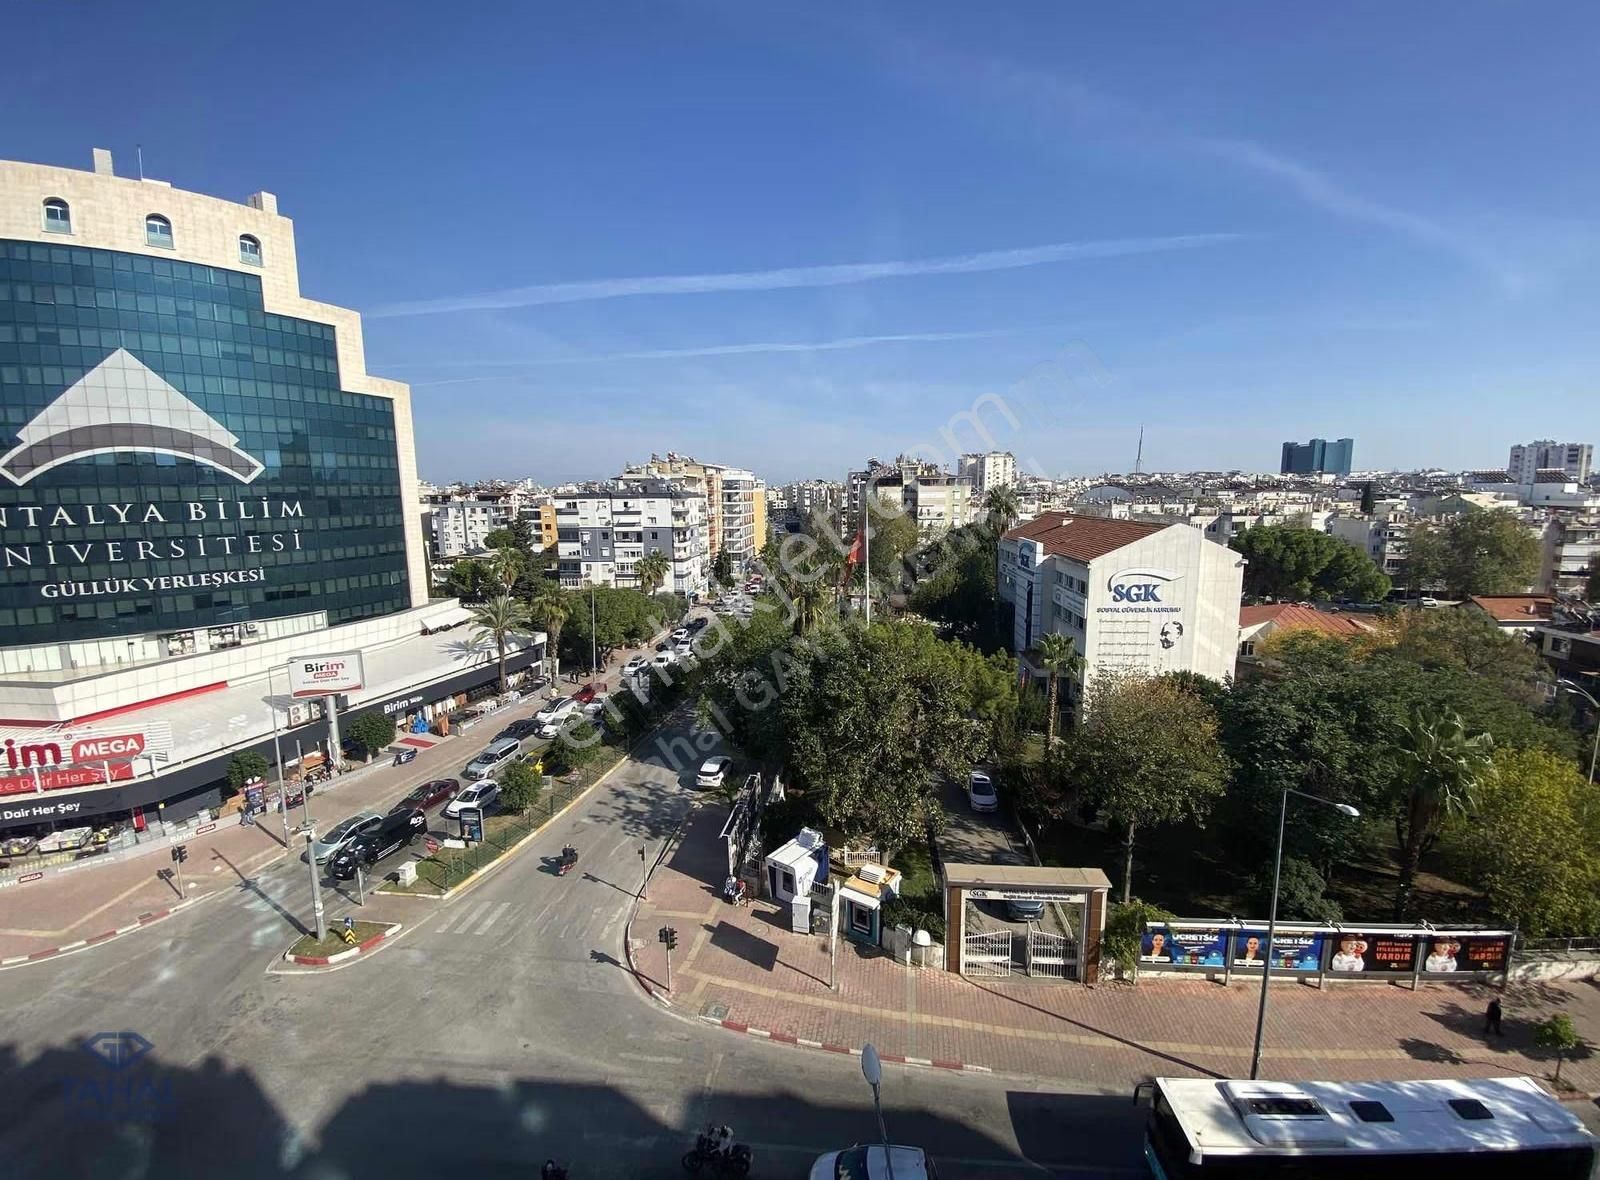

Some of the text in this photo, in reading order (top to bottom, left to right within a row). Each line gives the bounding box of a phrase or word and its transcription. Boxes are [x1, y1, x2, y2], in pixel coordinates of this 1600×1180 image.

[0, 497, 305, 527] TALYA BİLİM
[4, 529, 302, 567] NİVERSİTESİ
[41, 567, 265, 598] GÜLLÜK YERLEŞKESİ
[1112, 583, 1162, 603] SGK
[304, 662, 345, 673] Birim
[315, 671, 337, 679] MEGA
[384, 700, 409, 714] Birim
[0, 738, 140, 769] im MEGA
[57, 772, 88, 785] Her
[4, 802, 81, 820] Dair Her Şey
[170, 831, 195, 843] Birim
[20, 873, 42, 882] MEGA
[1376, 953, 1410, 961] VARDIR
